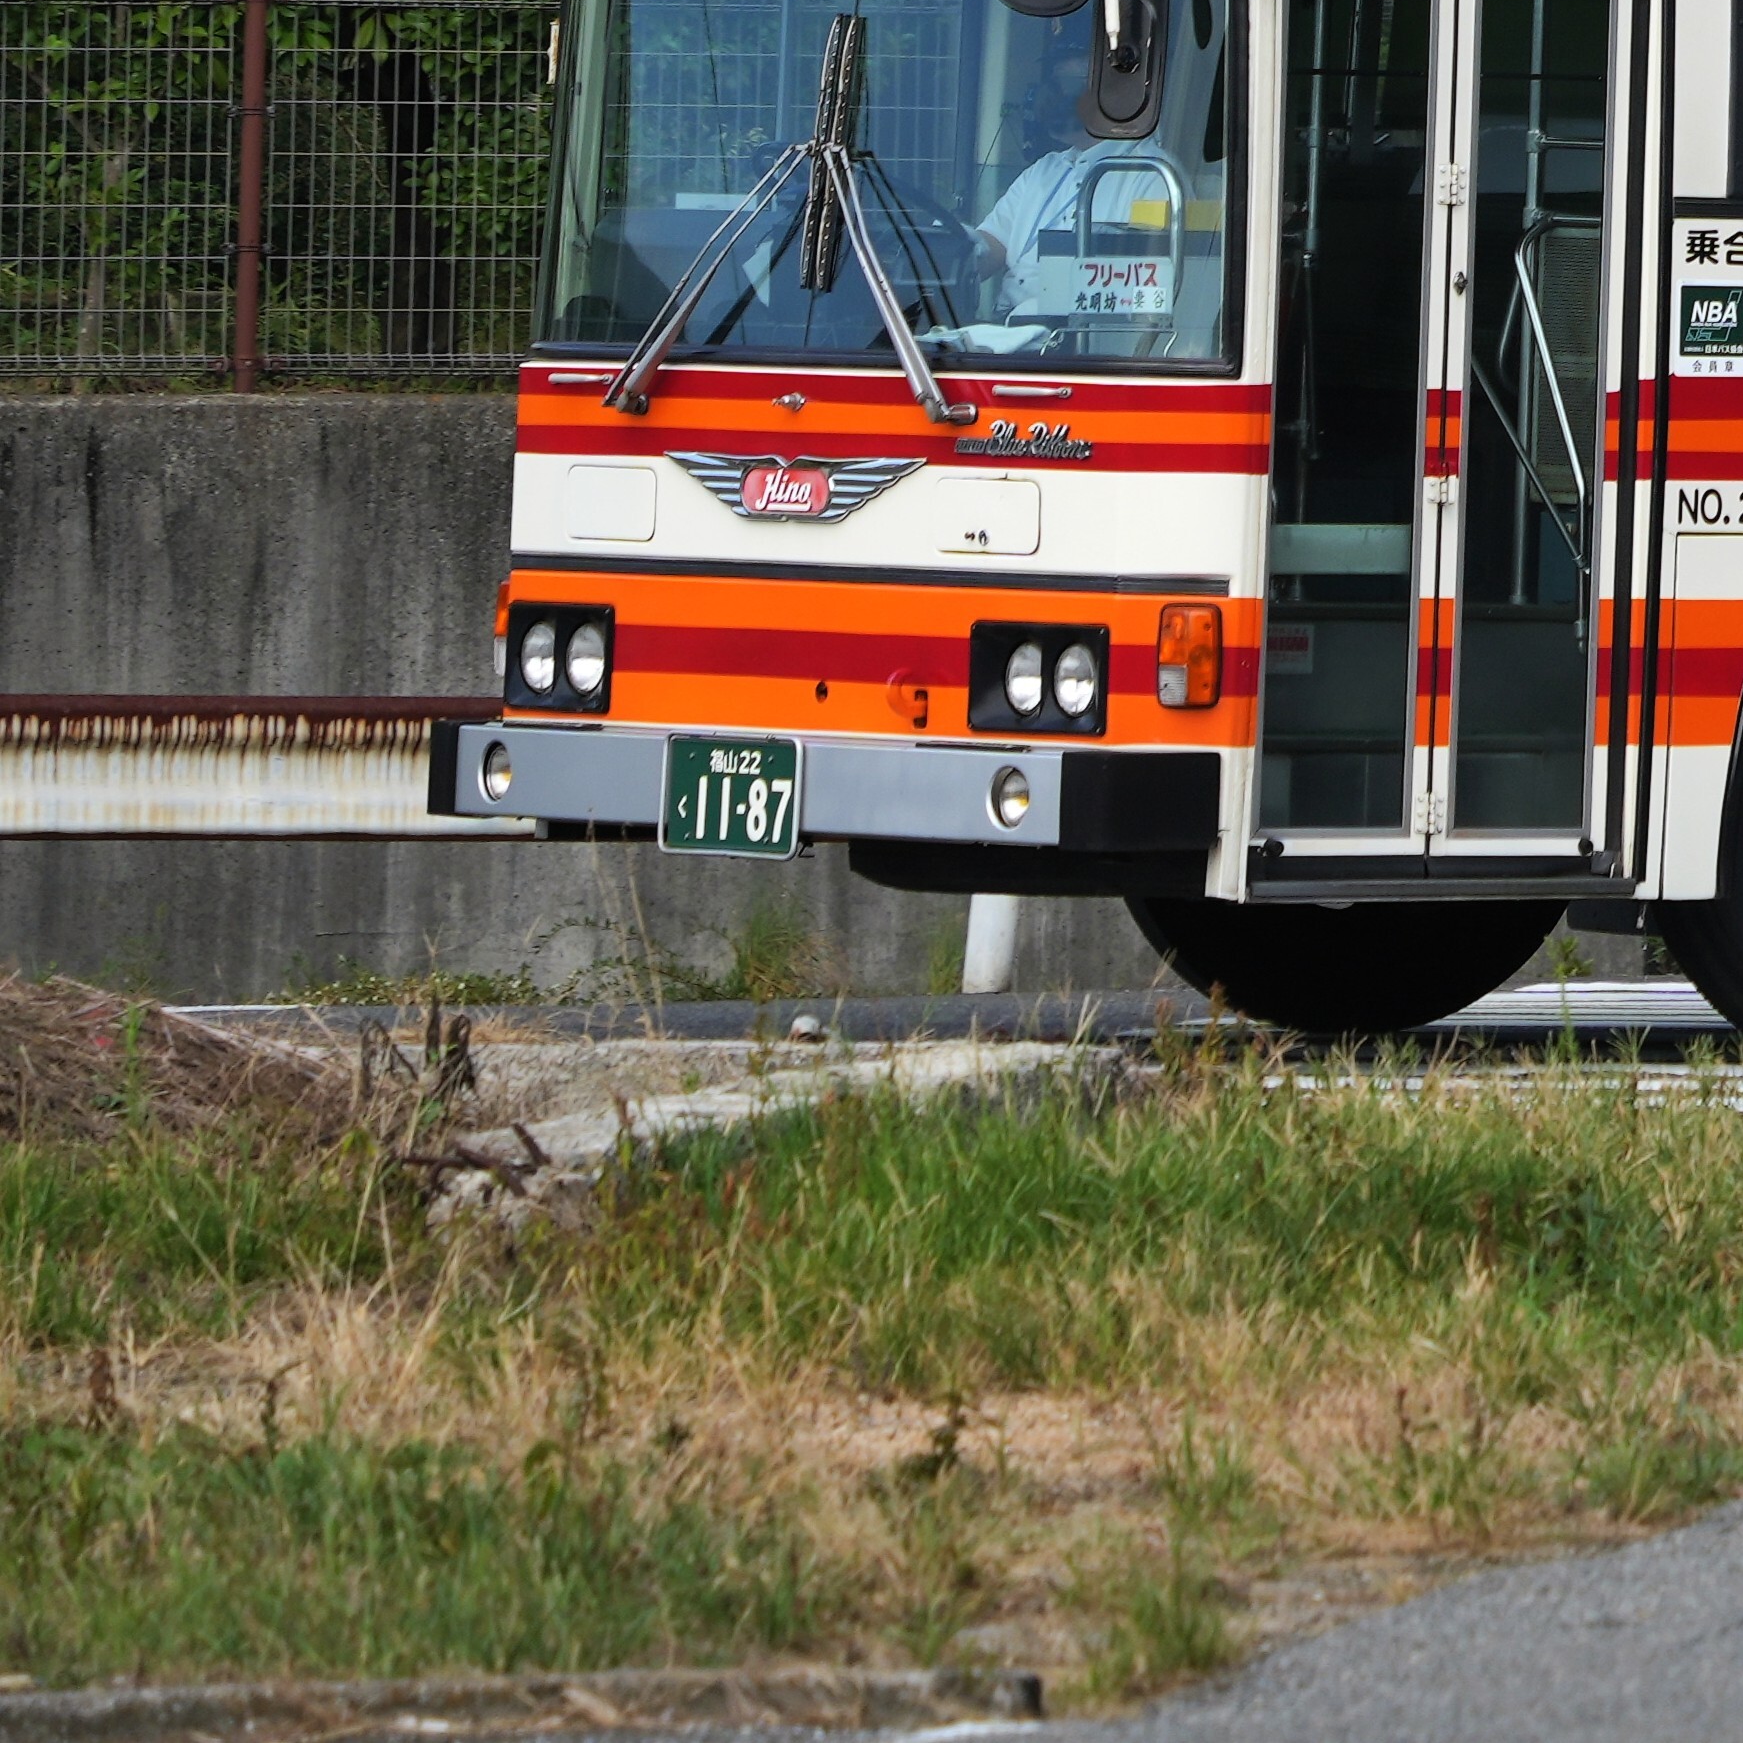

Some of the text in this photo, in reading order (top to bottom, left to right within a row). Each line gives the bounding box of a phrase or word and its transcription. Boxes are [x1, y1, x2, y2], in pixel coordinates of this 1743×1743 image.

[1084, 263, 1157, 287] フリーバス
[1690, 300, 1738, 323] NBA
[755, 468, 812, 511] Hino
[695, 774, 793, 844] 11-87
